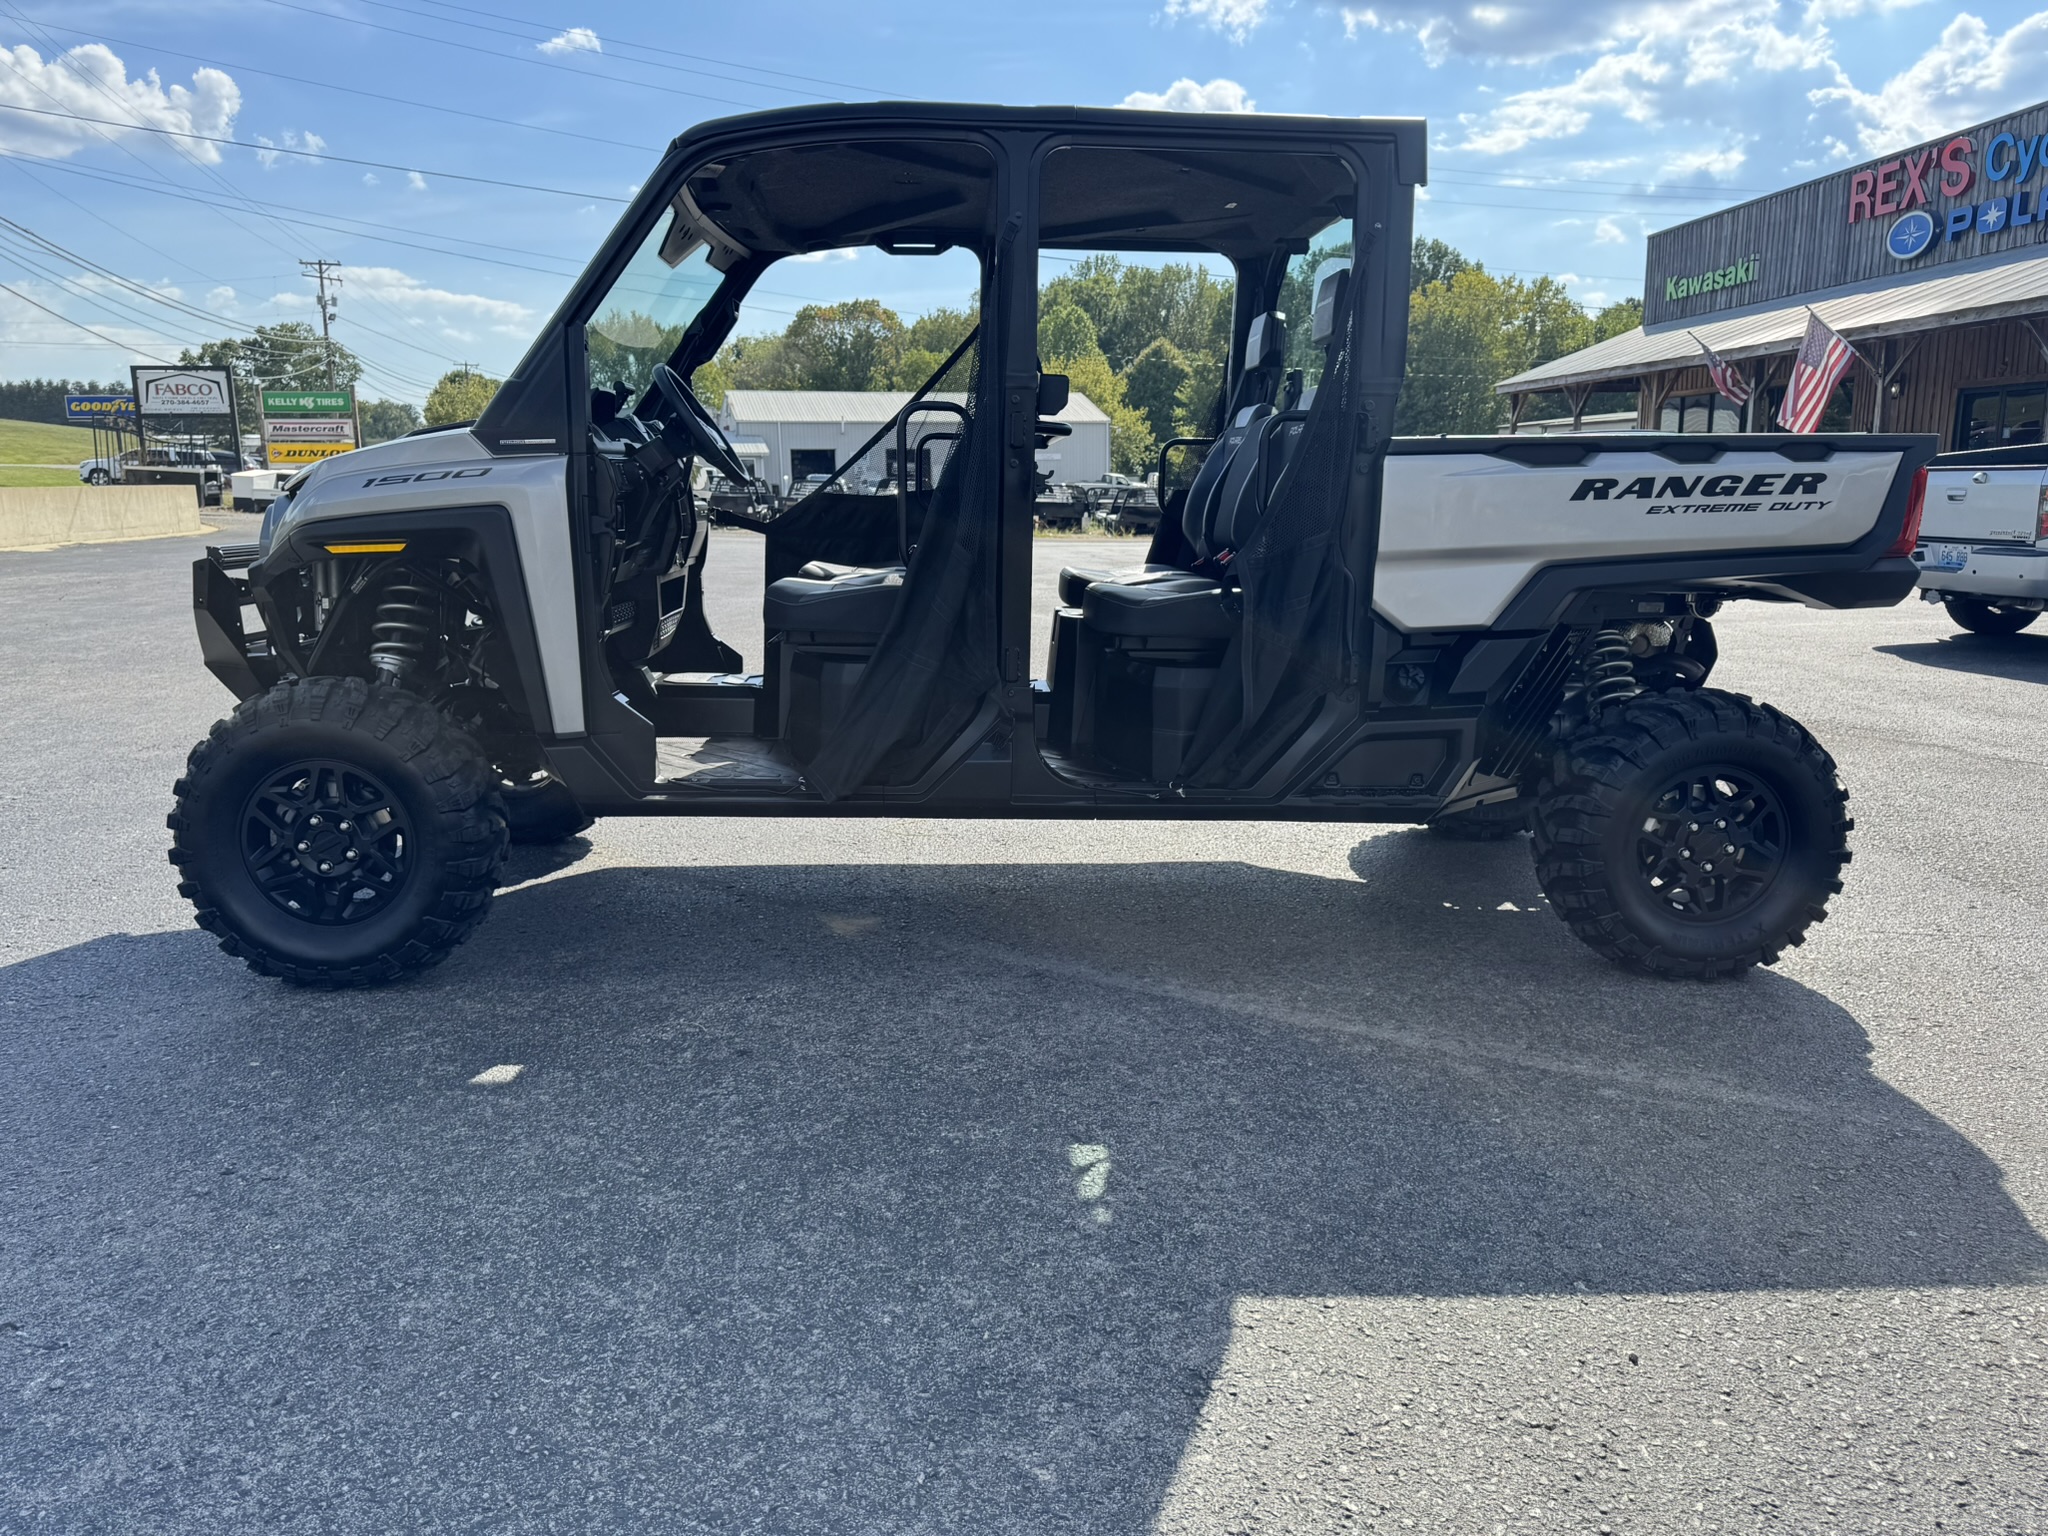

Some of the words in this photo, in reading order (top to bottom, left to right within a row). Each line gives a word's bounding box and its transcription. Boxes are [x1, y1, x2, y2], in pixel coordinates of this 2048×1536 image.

[1848, 137, 1977, 224] REX'S
[1666, 253, 1757, 301] Kawasaki
[155, 383, 213, 396] FABCO
[70, 400, 136, 412] GOODYE
[267, 398, 297, 406] KELLY
[316, 397, 344, 406] TIRES
[272, 425, 345, 433] Mastercraft
[362, 467, 493, 489] 1500
[1568, 472, 1828, 501] RANGER
[1645, 502, 1763, 515] EXTREME
[1768, 500, 1833, 511] DUTY
